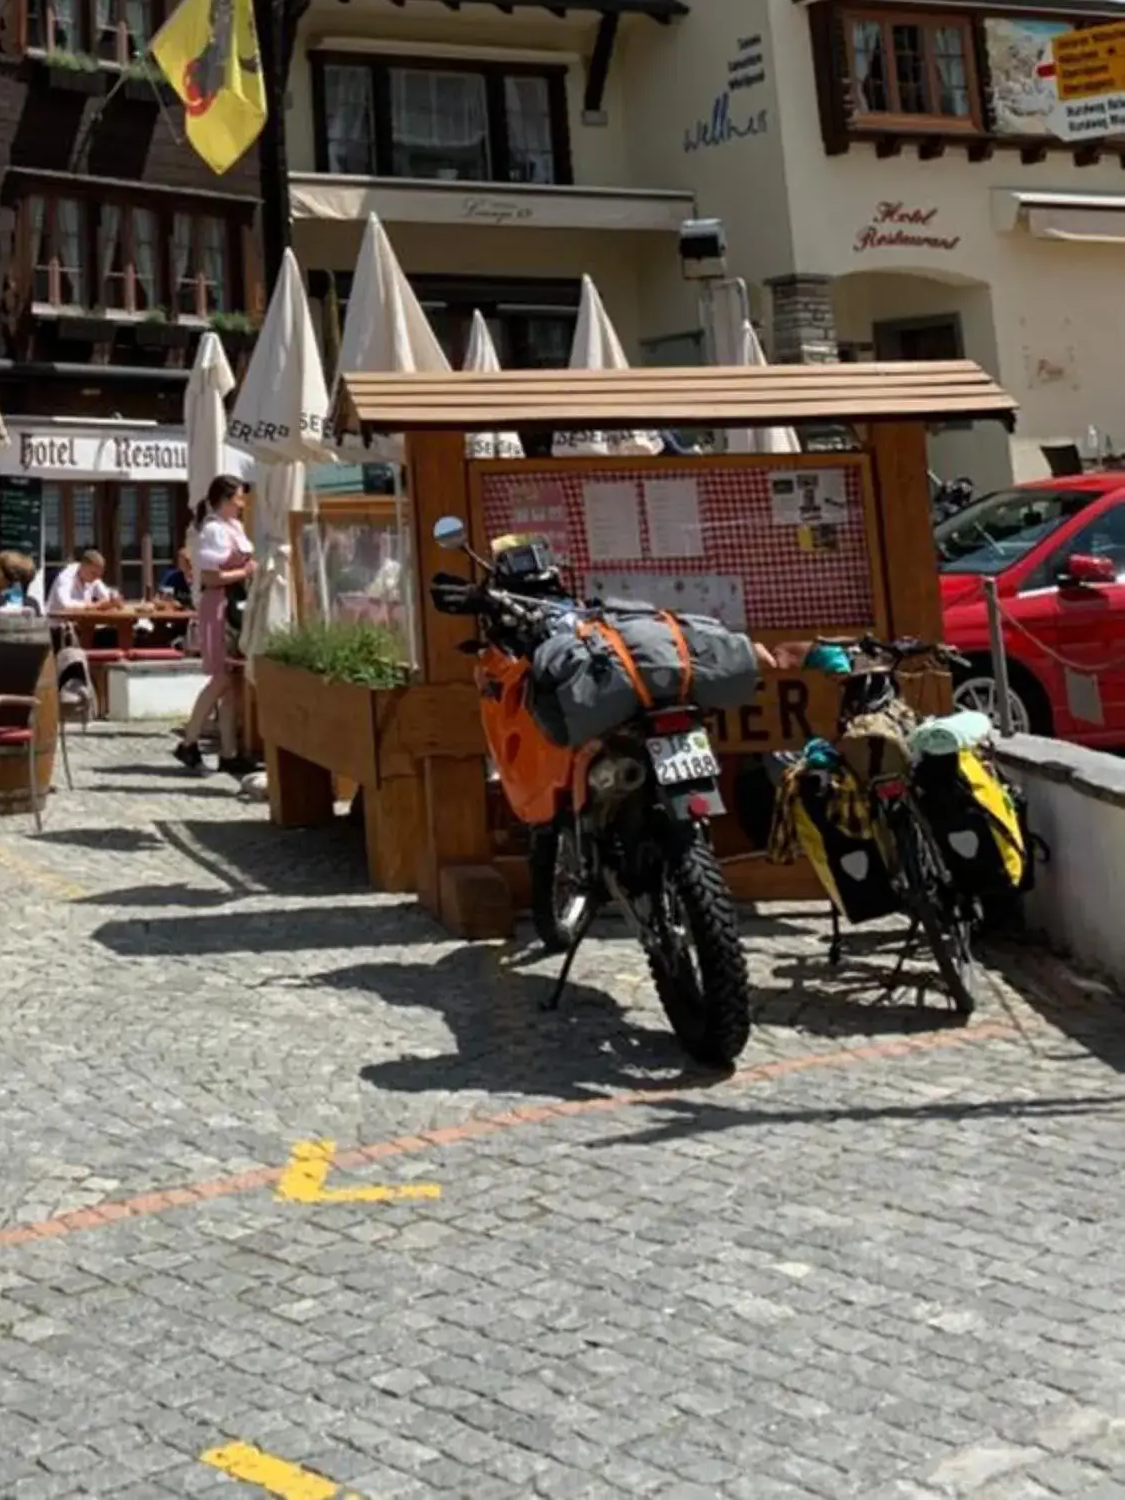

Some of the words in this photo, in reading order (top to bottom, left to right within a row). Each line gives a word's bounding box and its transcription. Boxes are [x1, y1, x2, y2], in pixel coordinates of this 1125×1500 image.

[873, 200, 938, 226] Hotel
[852, 226, 961, 252] Restaurant
[19, 432, 79, 471] Hotel
[113, 436, 188, 470] Restau
